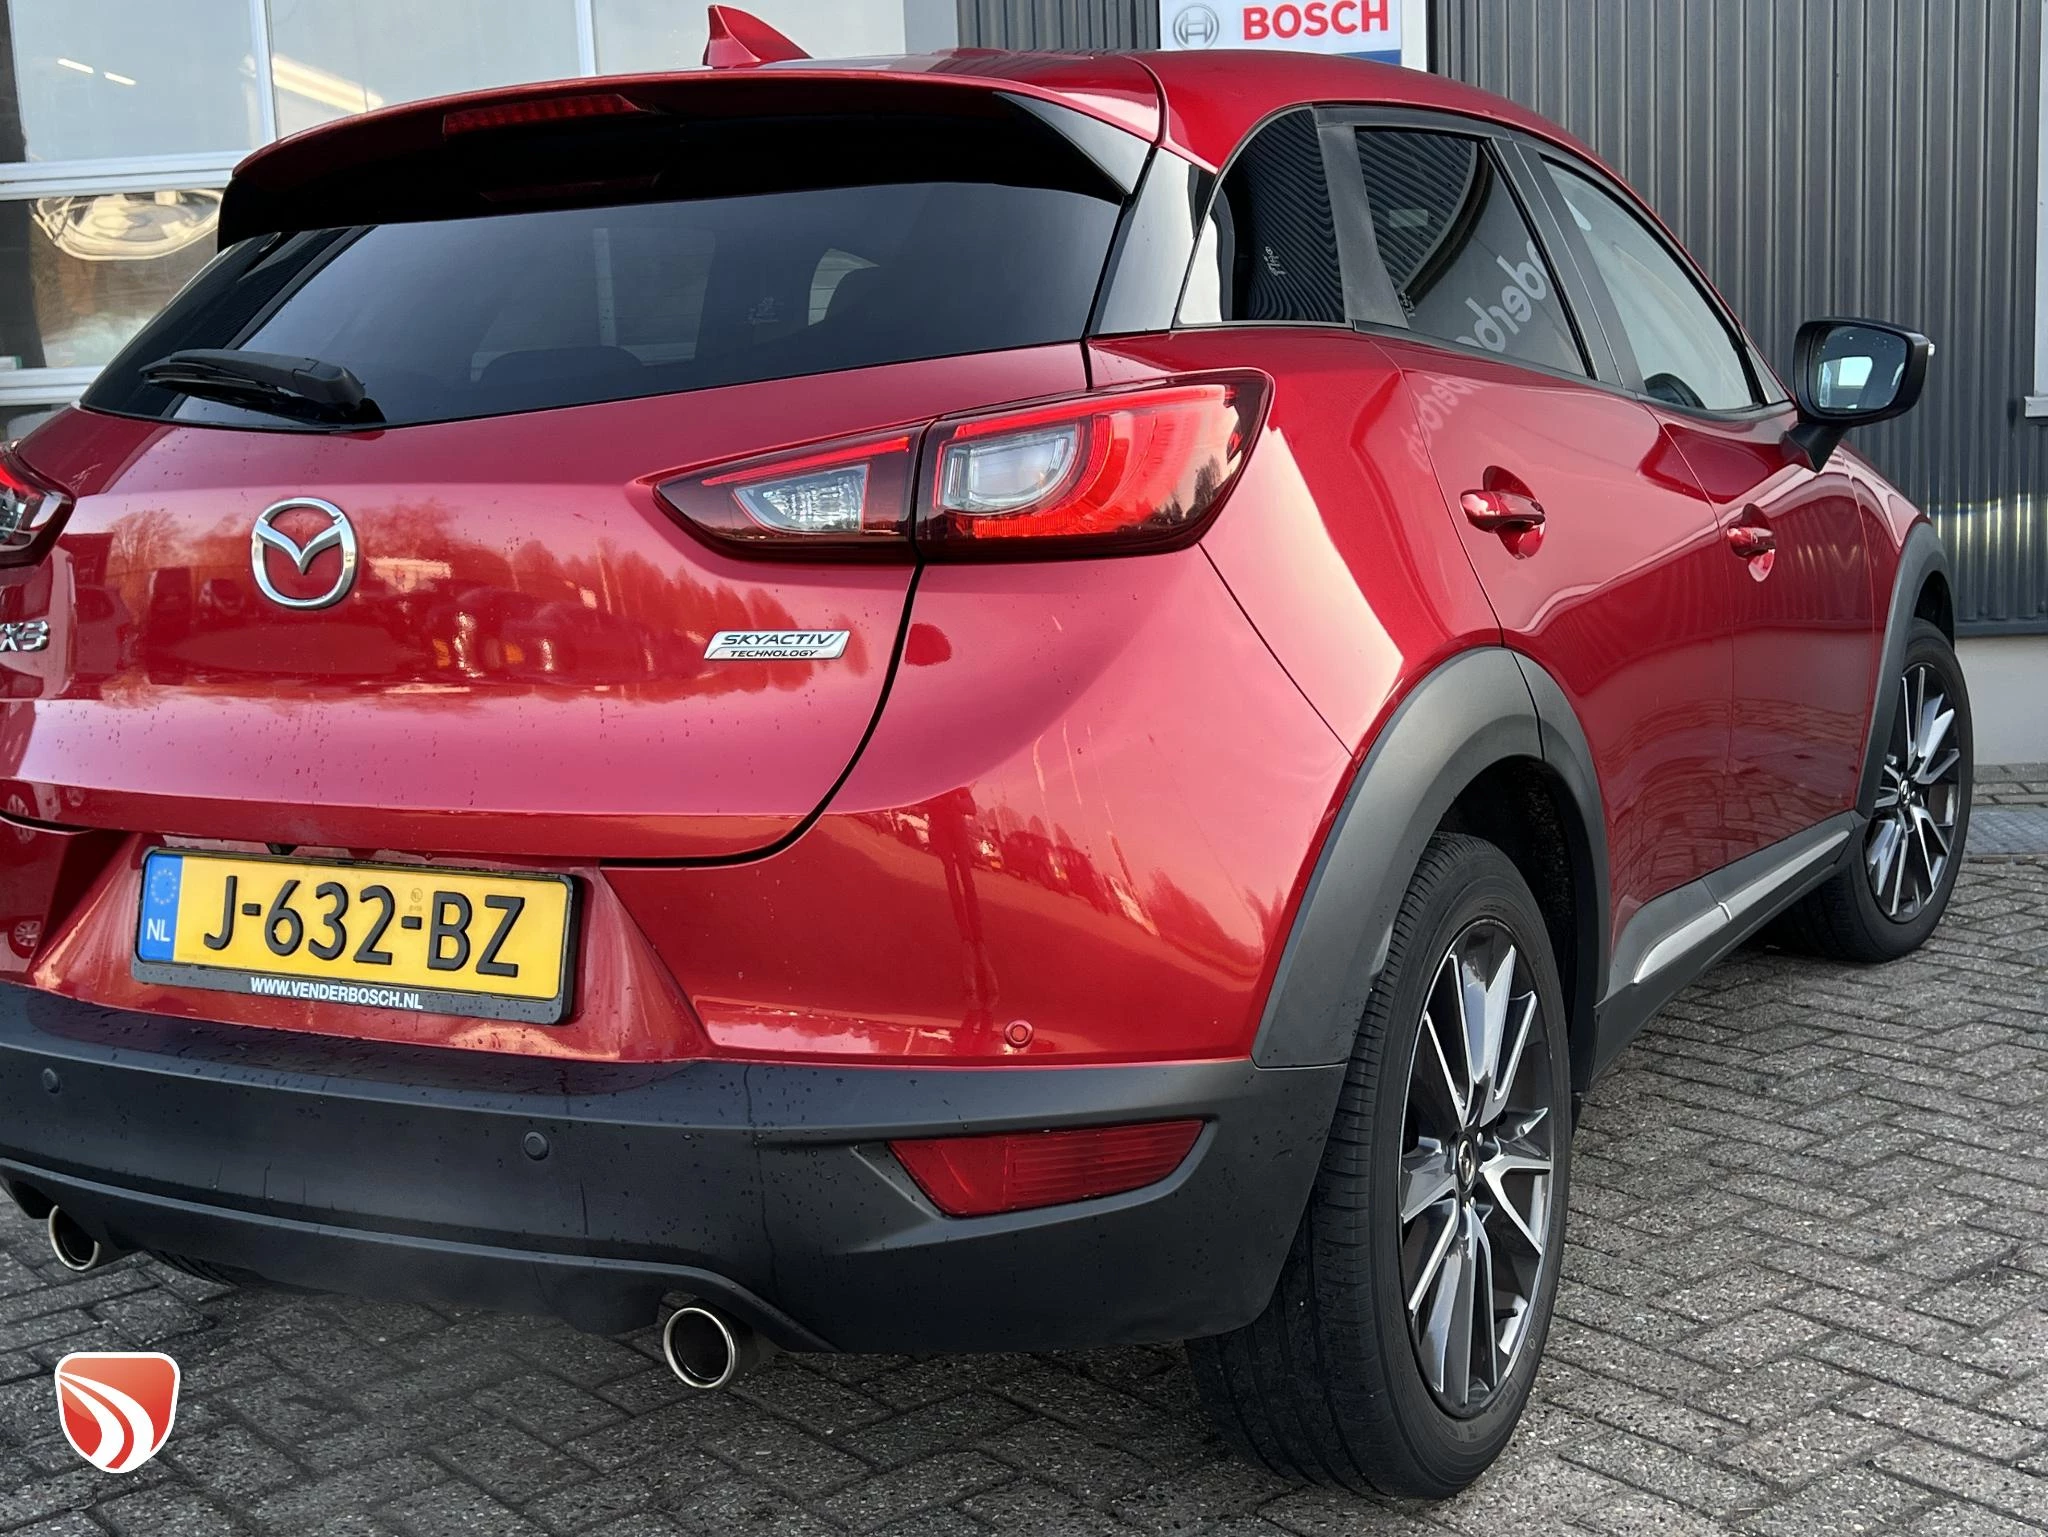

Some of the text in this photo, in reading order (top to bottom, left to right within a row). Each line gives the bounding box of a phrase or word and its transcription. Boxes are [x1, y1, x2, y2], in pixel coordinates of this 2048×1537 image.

[1244, 0, 1388, 40] BOSCH
[721, 634, 834, 645] SKYACTIV
[146, 918, 171, 942] NL
[203, 875, 526, 977] J-632-BZ
[250, 976, 423, 1009] WWW.VENDERBOSCH.NL
